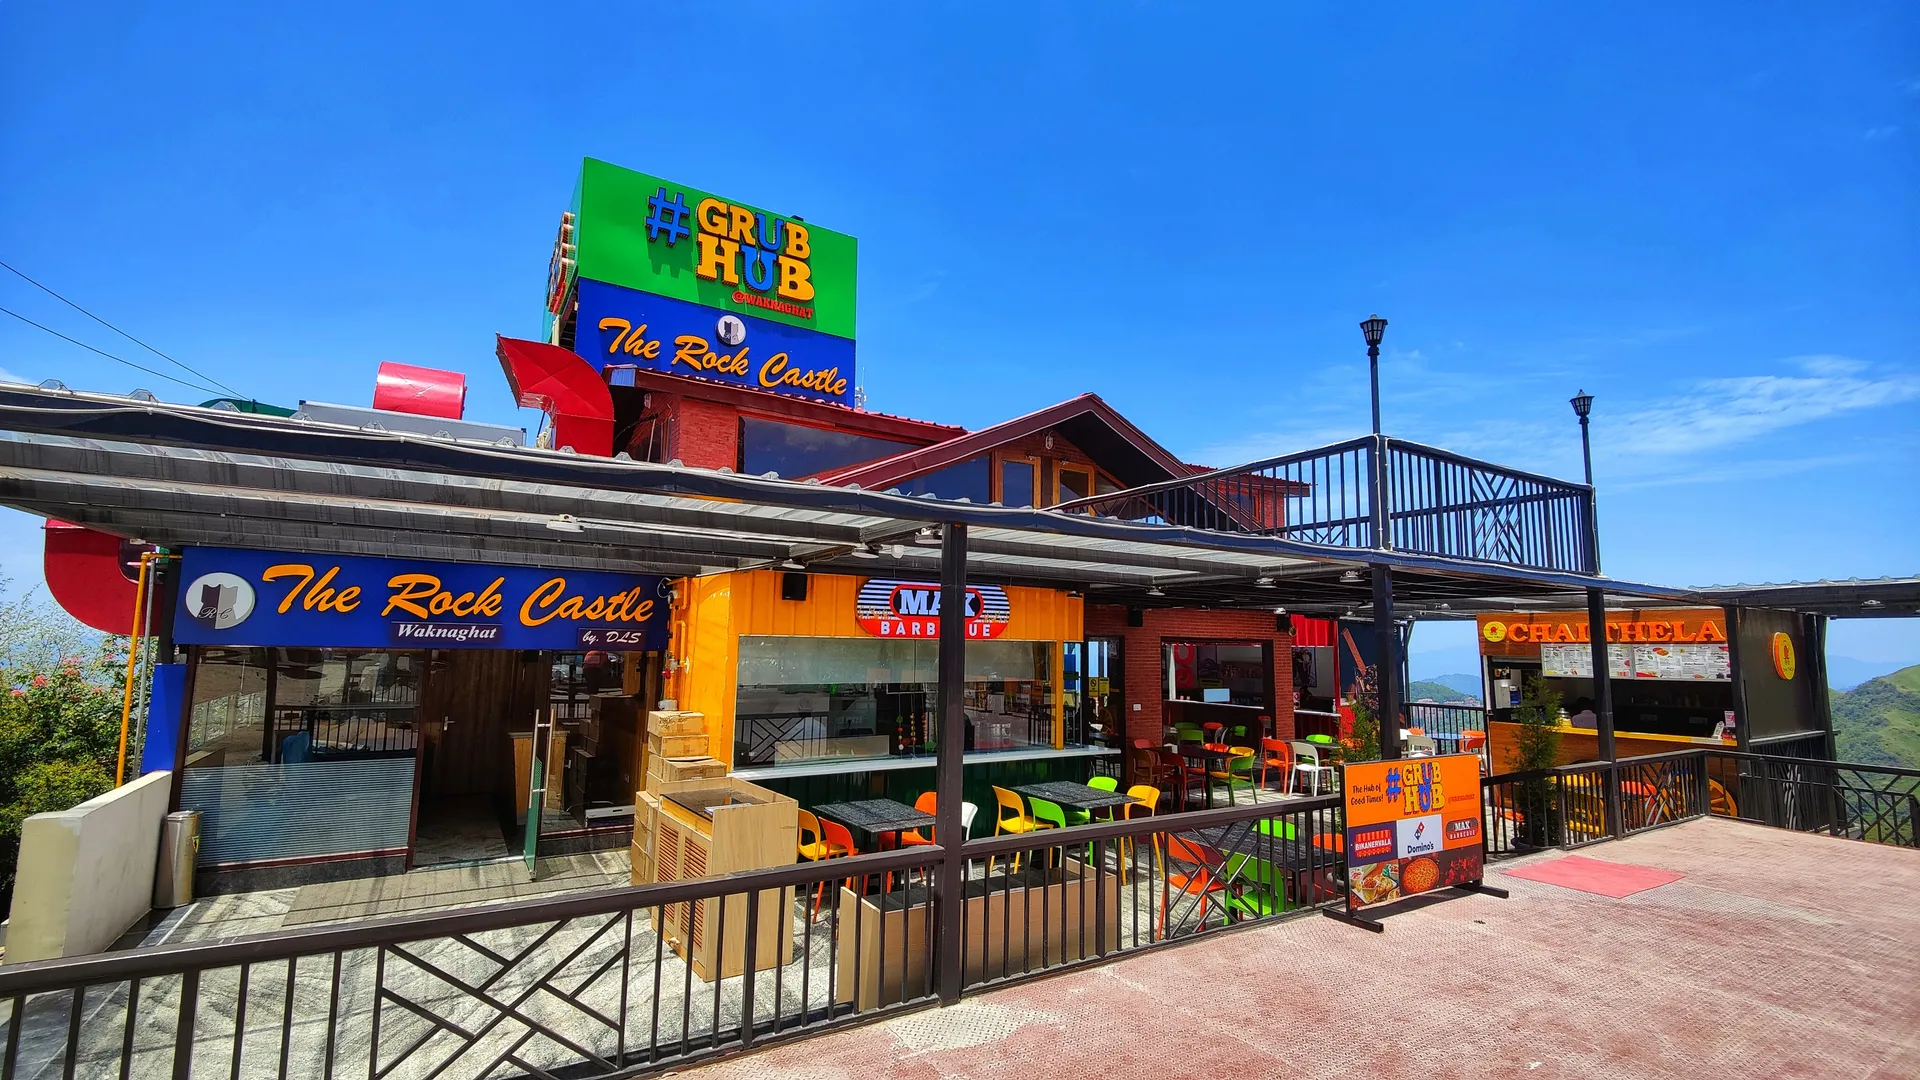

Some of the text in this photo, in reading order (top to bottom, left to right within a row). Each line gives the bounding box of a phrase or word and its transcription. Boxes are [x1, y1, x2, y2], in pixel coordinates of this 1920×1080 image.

[696, 233, 815, 302] HUB
[732, 291, 813, 319] @WAKNAGHAT
[599, 317, 847, 395] The Rock Castle
[262, 564, 654, 627] The Rock Castle
[398, 624, 497, 641] Waknaghat
[880, 621, 991, 637] BARBUE
[1508, 623, 1591, 643] CHAI
[606, 631, 642, 644] DLS
[1352, 785, 1363, 794] The
[1364, 784, 1375, 793] Hub
[1351, 796, 1365, 806] Good
[1403, 783, 1446, 815] HUB
[1455, 820, 1470, 831] MAX
[1355, 839, 1392, 851] BIKANERVALA
[1407, 841, 1434, 854] Domino's
